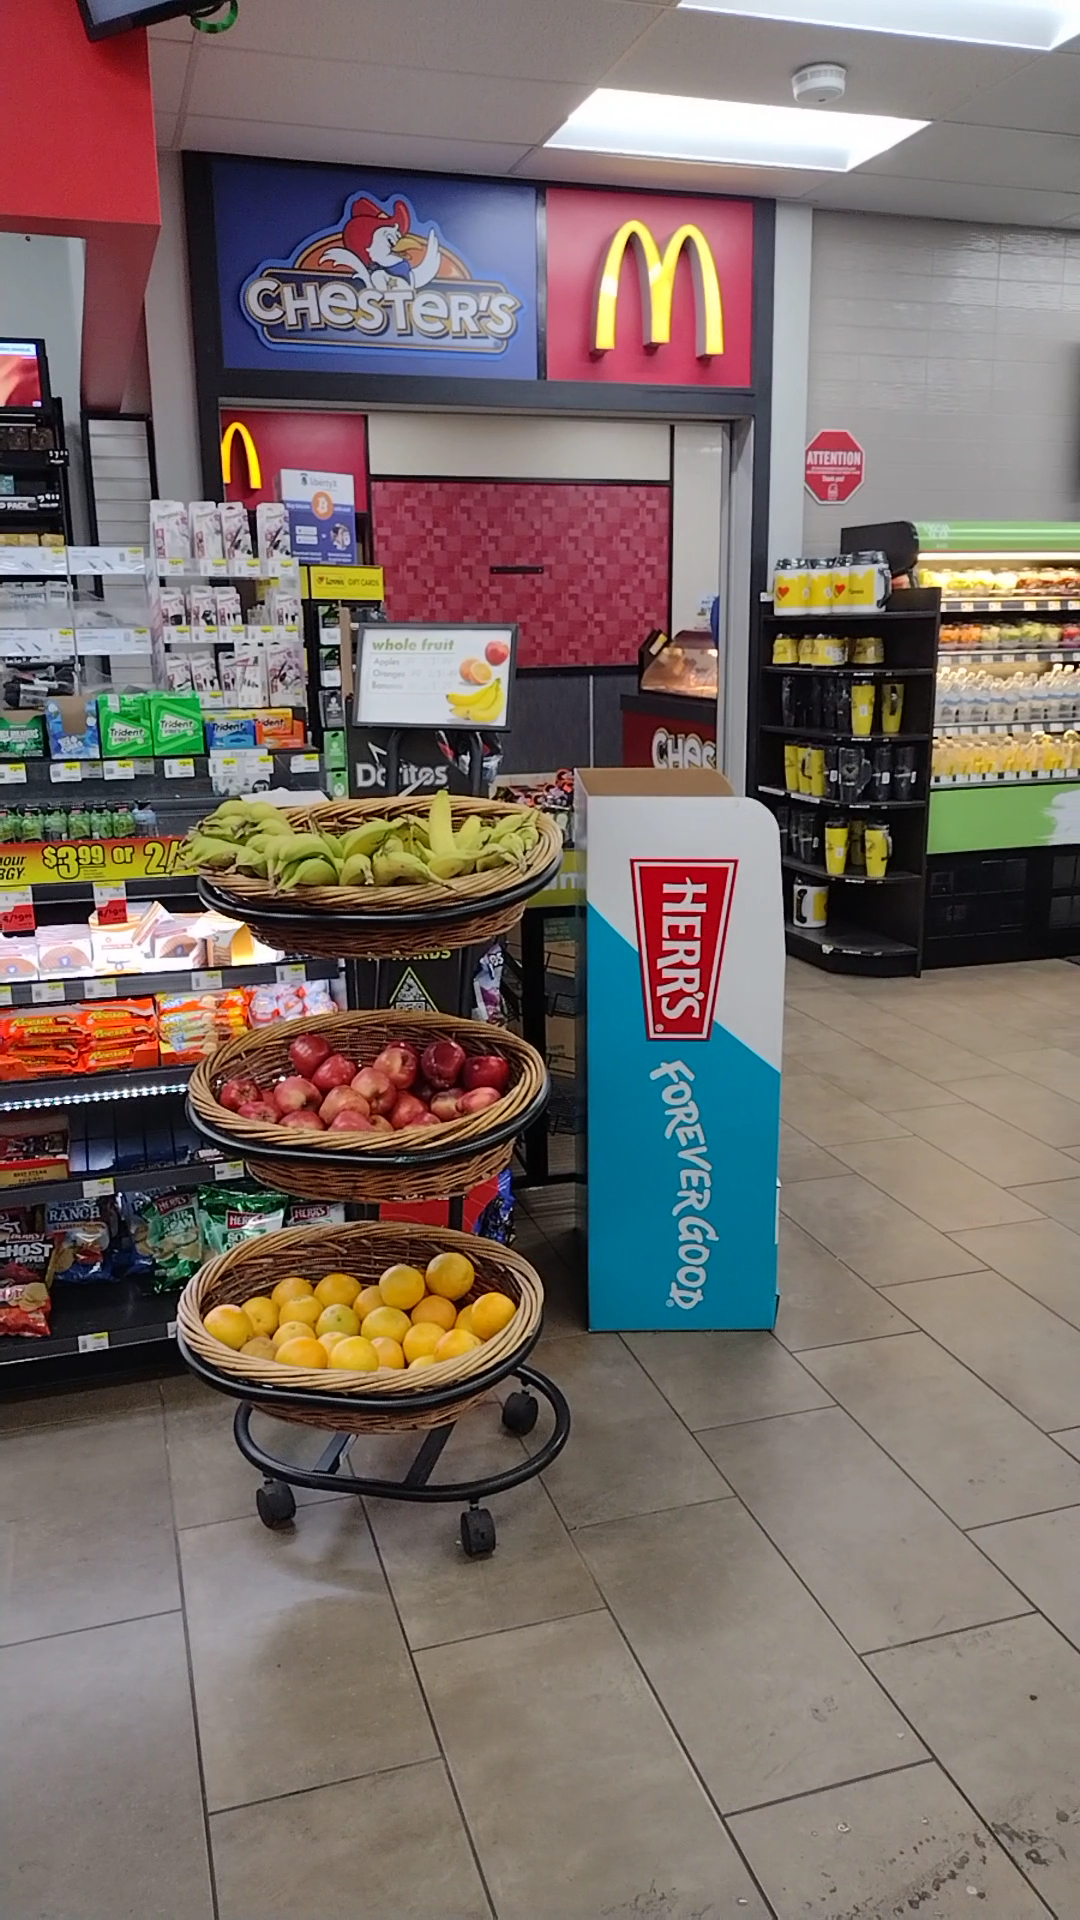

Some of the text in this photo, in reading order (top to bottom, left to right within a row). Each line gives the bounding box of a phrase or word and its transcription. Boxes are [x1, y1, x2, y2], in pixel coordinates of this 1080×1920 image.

[806, 451, 861, 466] ATTENTION
[372, 638, 454, 651] whole fruit
[373, 657, 400, 667] Apples
[373, 668, 405, 679] Oranges
[160, 720, 194, 729] Trident
[213, 722, 245, 732] Trident
[110, 728, 144, 737] Trident
[355, 762, 449, 788] Doitos
[111, 846, 134, 864] or
[655, 877, 707, 1020] HERR'S
[649, 1059, 719, 1309] FOREVER GOOD
[49, 1207, 102, 1221] RANCH
[294, 1206, 327, 1219] HERR'S
